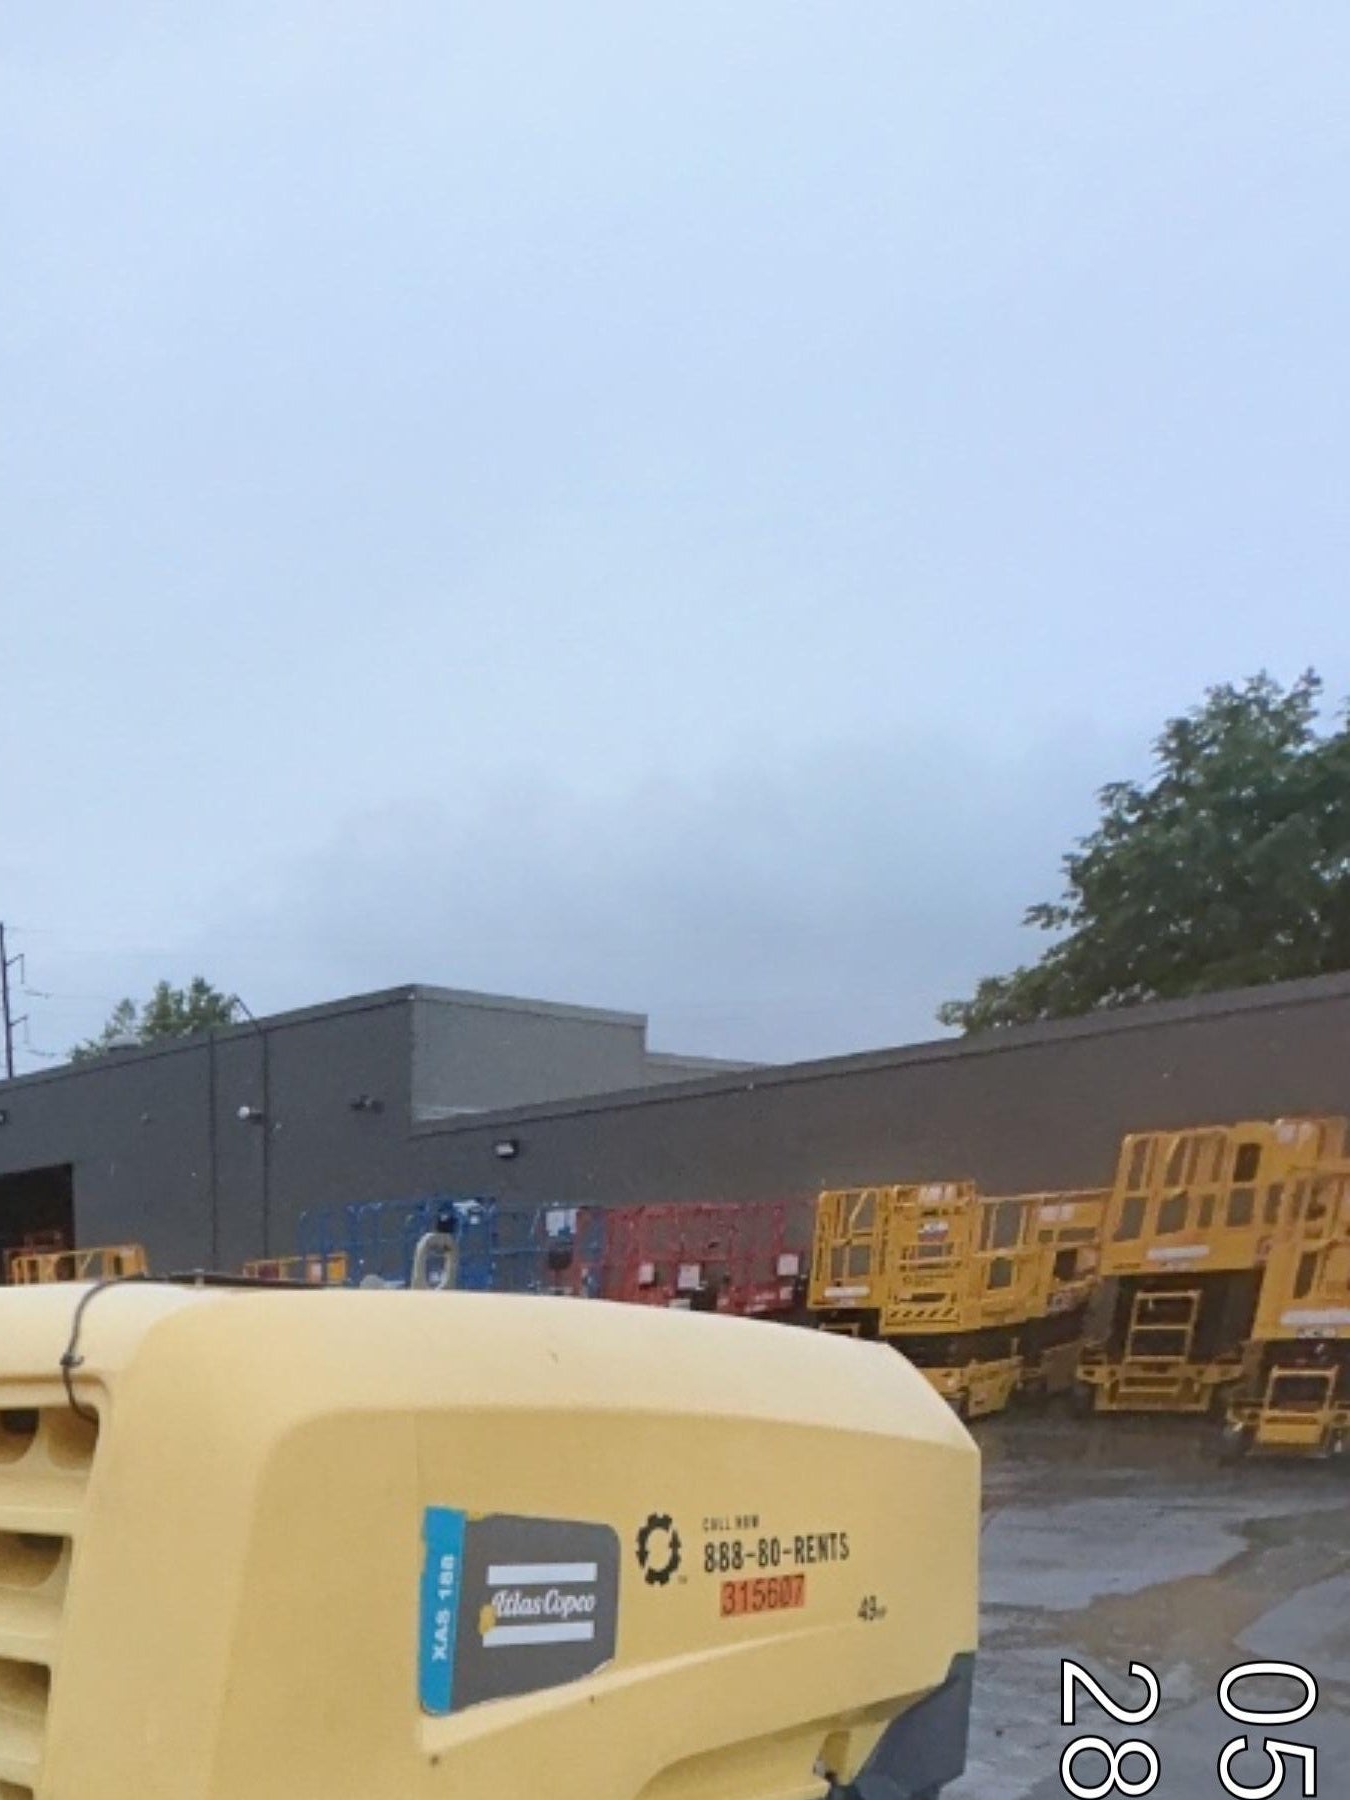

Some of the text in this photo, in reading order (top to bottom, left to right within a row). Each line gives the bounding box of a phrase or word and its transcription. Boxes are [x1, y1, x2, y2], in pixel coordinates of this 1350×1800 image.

[704, 1532, 850, 1573] 888-80-RENTS
[491, 1588, 596, 1619] Atlas Copco
[720, 1573, 805, 1616] 315607
[431, 1607, 450, 1661] XAS
